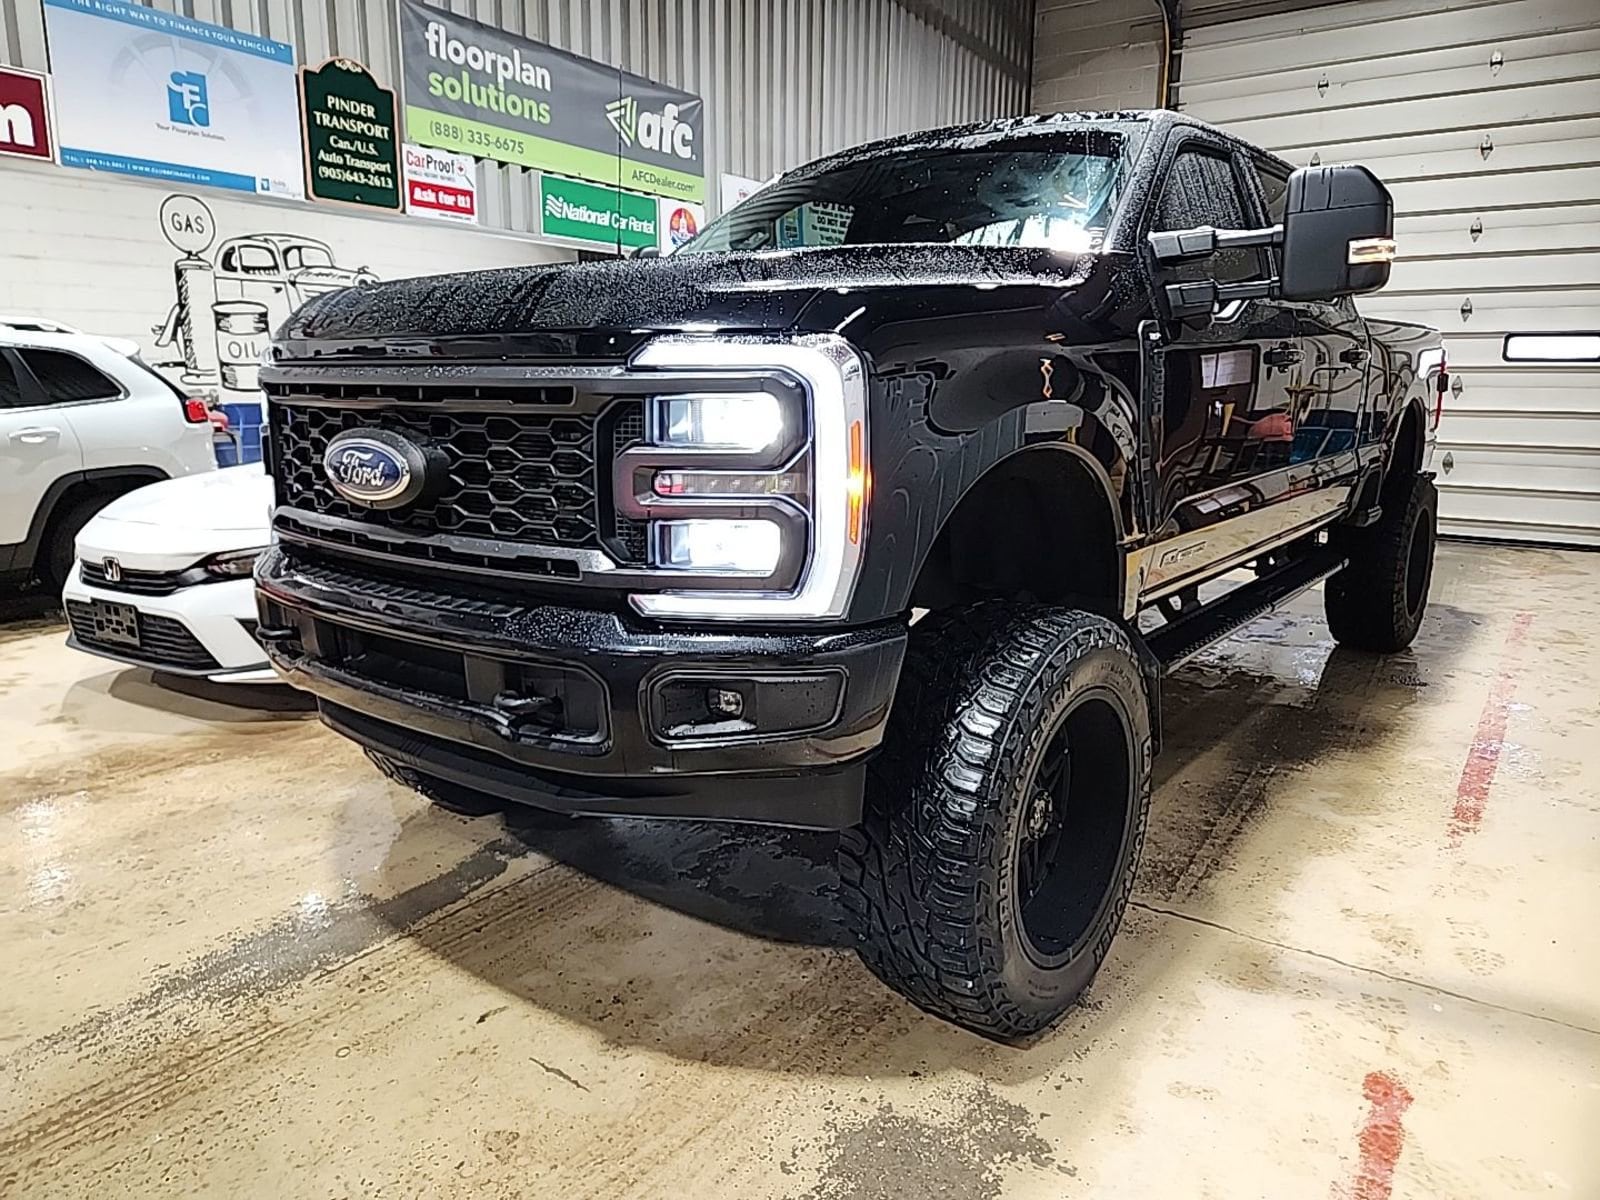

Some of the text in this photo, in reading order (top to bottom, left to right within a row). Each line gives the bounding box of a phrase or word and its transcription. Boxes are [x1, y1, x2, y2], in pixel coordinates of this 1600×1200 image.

[95, 1, 126, 15] RIGHT
[129, 9, 150, 21] WAY
[153, 16, 166, 27] TO
[169, 20, 210, 37] FINANCE
[212, 30, 236, 43] YOUR
[238, 39, 276, 55] VEHICLES
[425, 21, 552, 92] floorplan
[327, 95, 376, 119] PINDER
[428, 70, 551, 124] solutions
[313, 110, 390, 140] TRANSPORT
[430, 120, 525, 154] (888) 335-6675
[318, 149, 392, 175] Auto Transport
[406, 150, 455, 175] CarProof
[318, 166, 394, 189] (905)643-2613
[413, 186, 437, 204] Ask
[438, 190, 456, 207] for
[171, 212, 205, 234] GAS
[561, 202, 656, 235] National Car Rental
[227, 341, 261, 360] OIL
[339, 449, 387, 486] Ford
